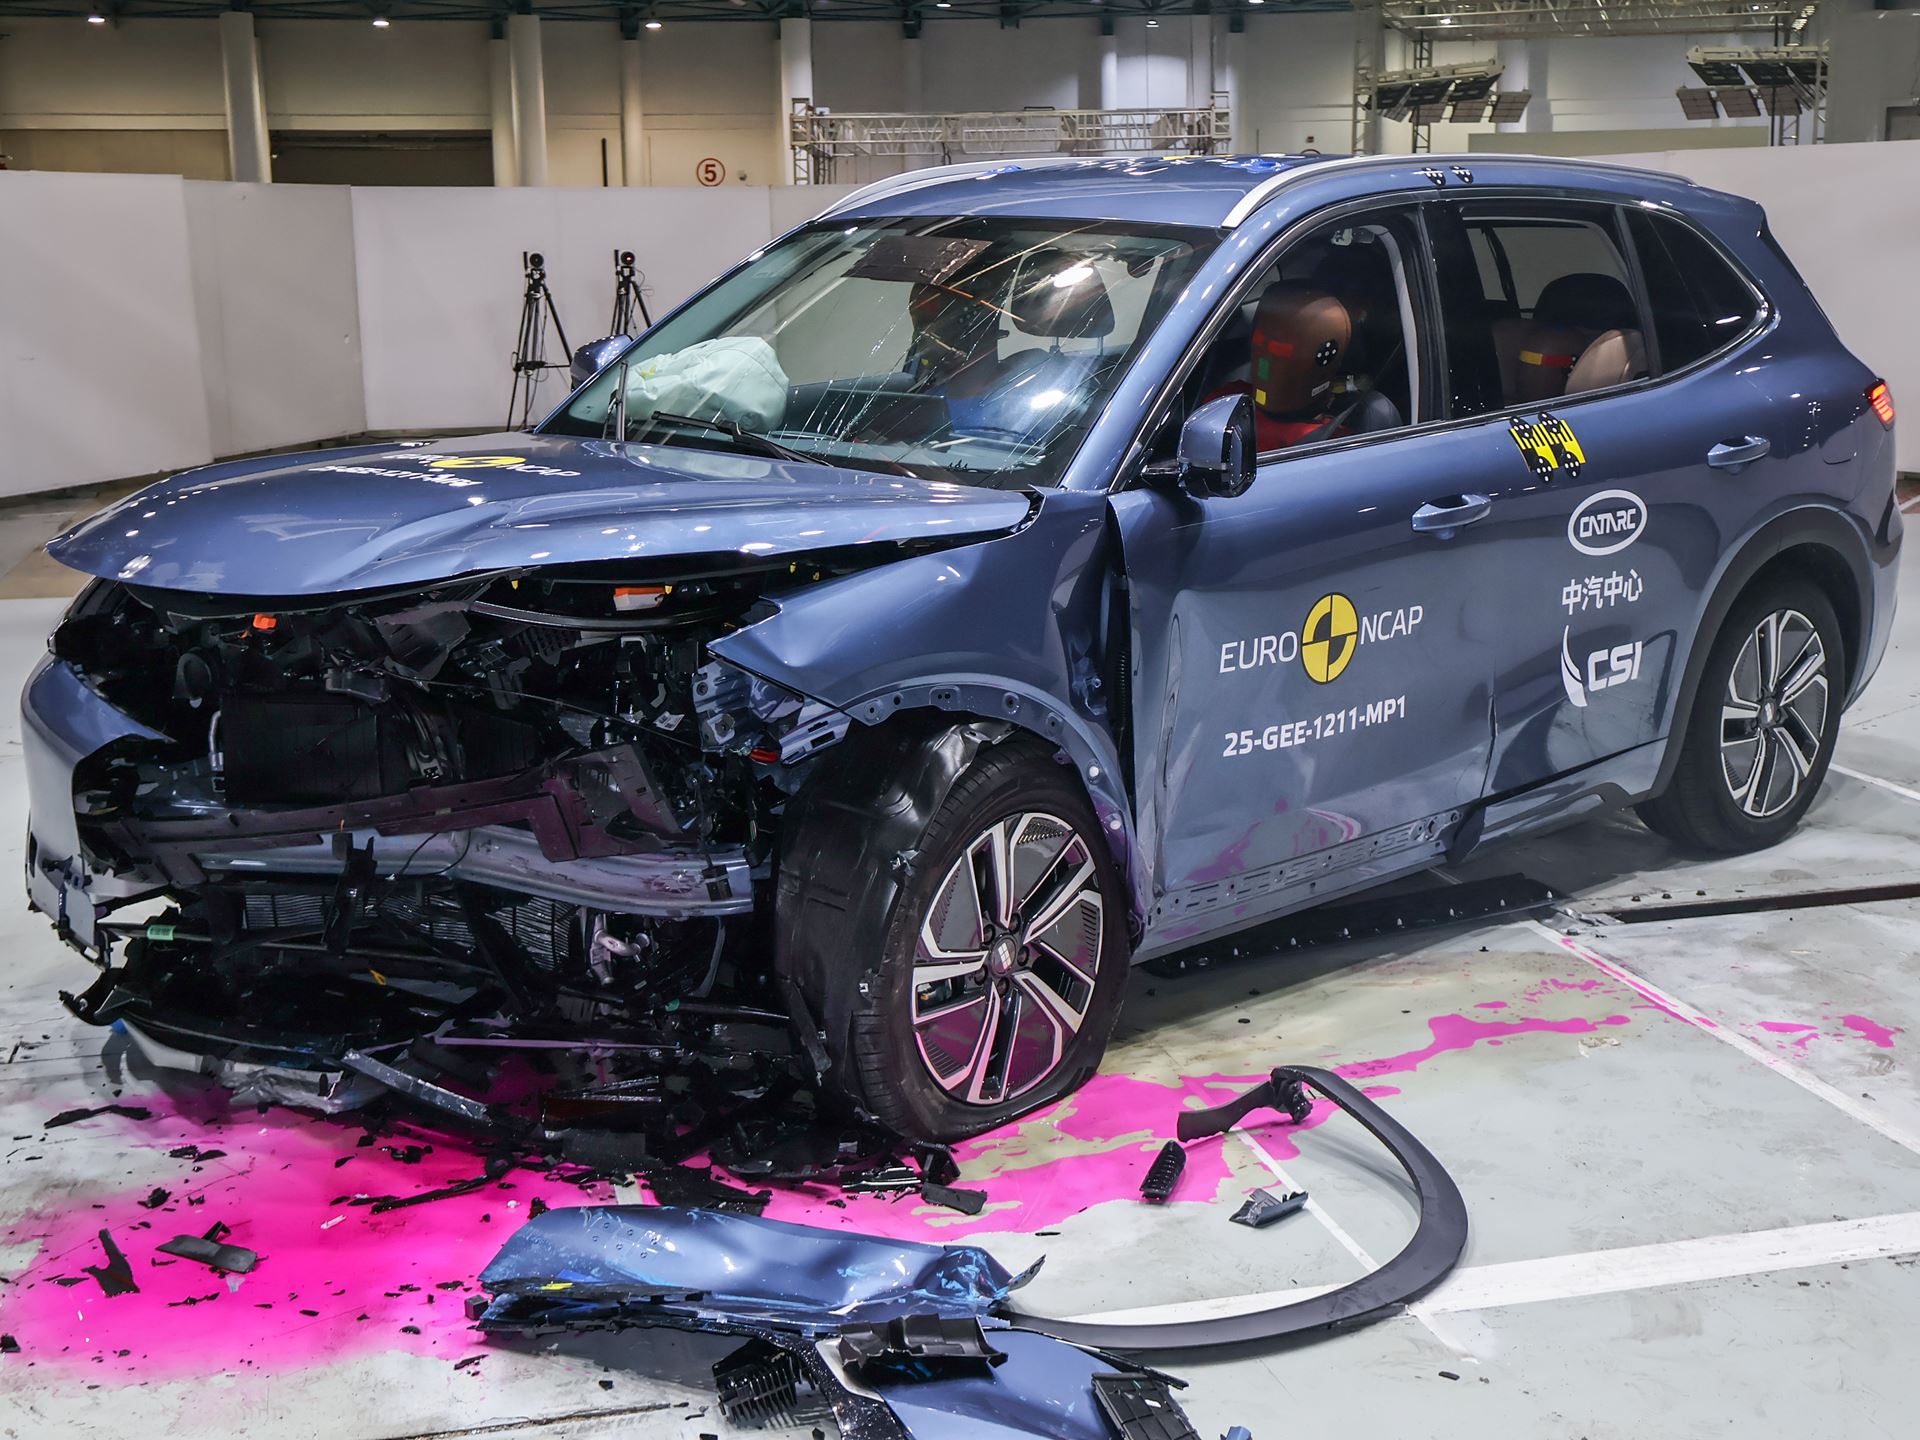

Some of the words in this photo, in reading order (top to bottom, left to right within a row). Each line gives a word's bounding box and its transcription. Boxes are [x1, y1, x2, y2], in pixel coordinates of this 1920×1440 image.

[704, 163, 717, 183] 5
[1579, 508, 1637, 538] CATARC
[1562, 568, 1643, 615] 中汽中心
[1219, 631, 1298, 674] EURO
[1360, 605, 1423, 645] NCAP
[1587, 640, 1643, 692] CSI
[1222, 695, 1406, 757] 25-GEE-1211-MP1
